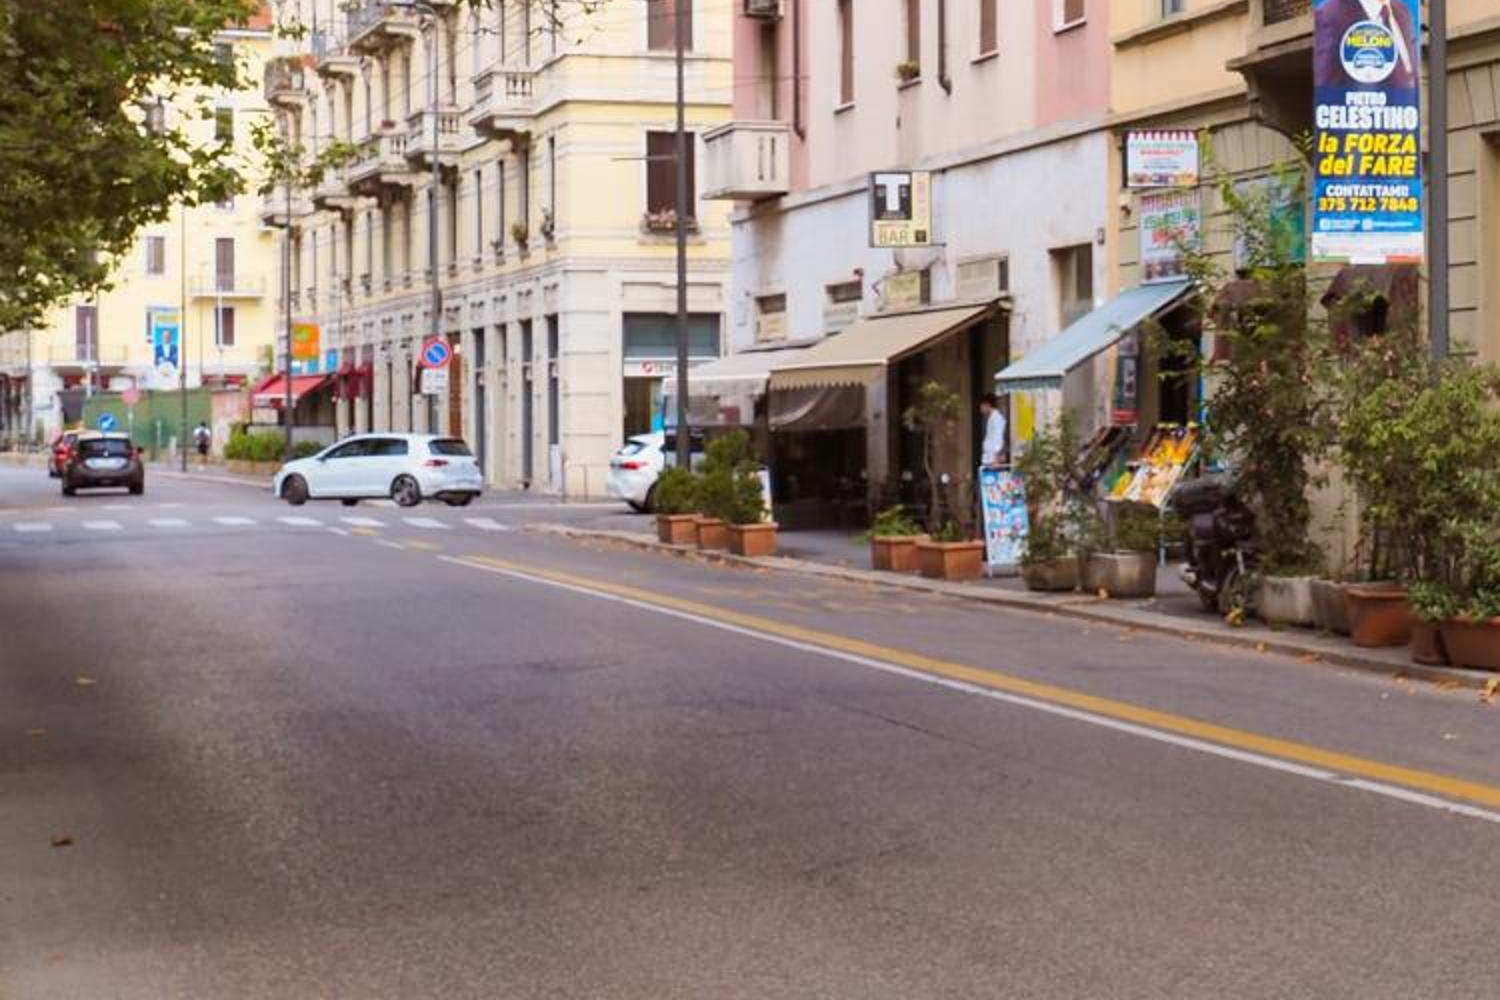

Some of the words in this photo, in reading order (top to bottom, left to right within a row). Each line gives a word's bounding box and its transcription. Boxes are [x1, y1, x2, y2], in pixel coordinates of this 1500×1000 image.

[1316, 104, 1418, 130] CELESTINO
[1319, 131, 1339, 153] la
[1344, 133, 1417, 154] FORZA
[1319, 154, 1354, 176] del
[1359, 155, 1416, 176] FARE
